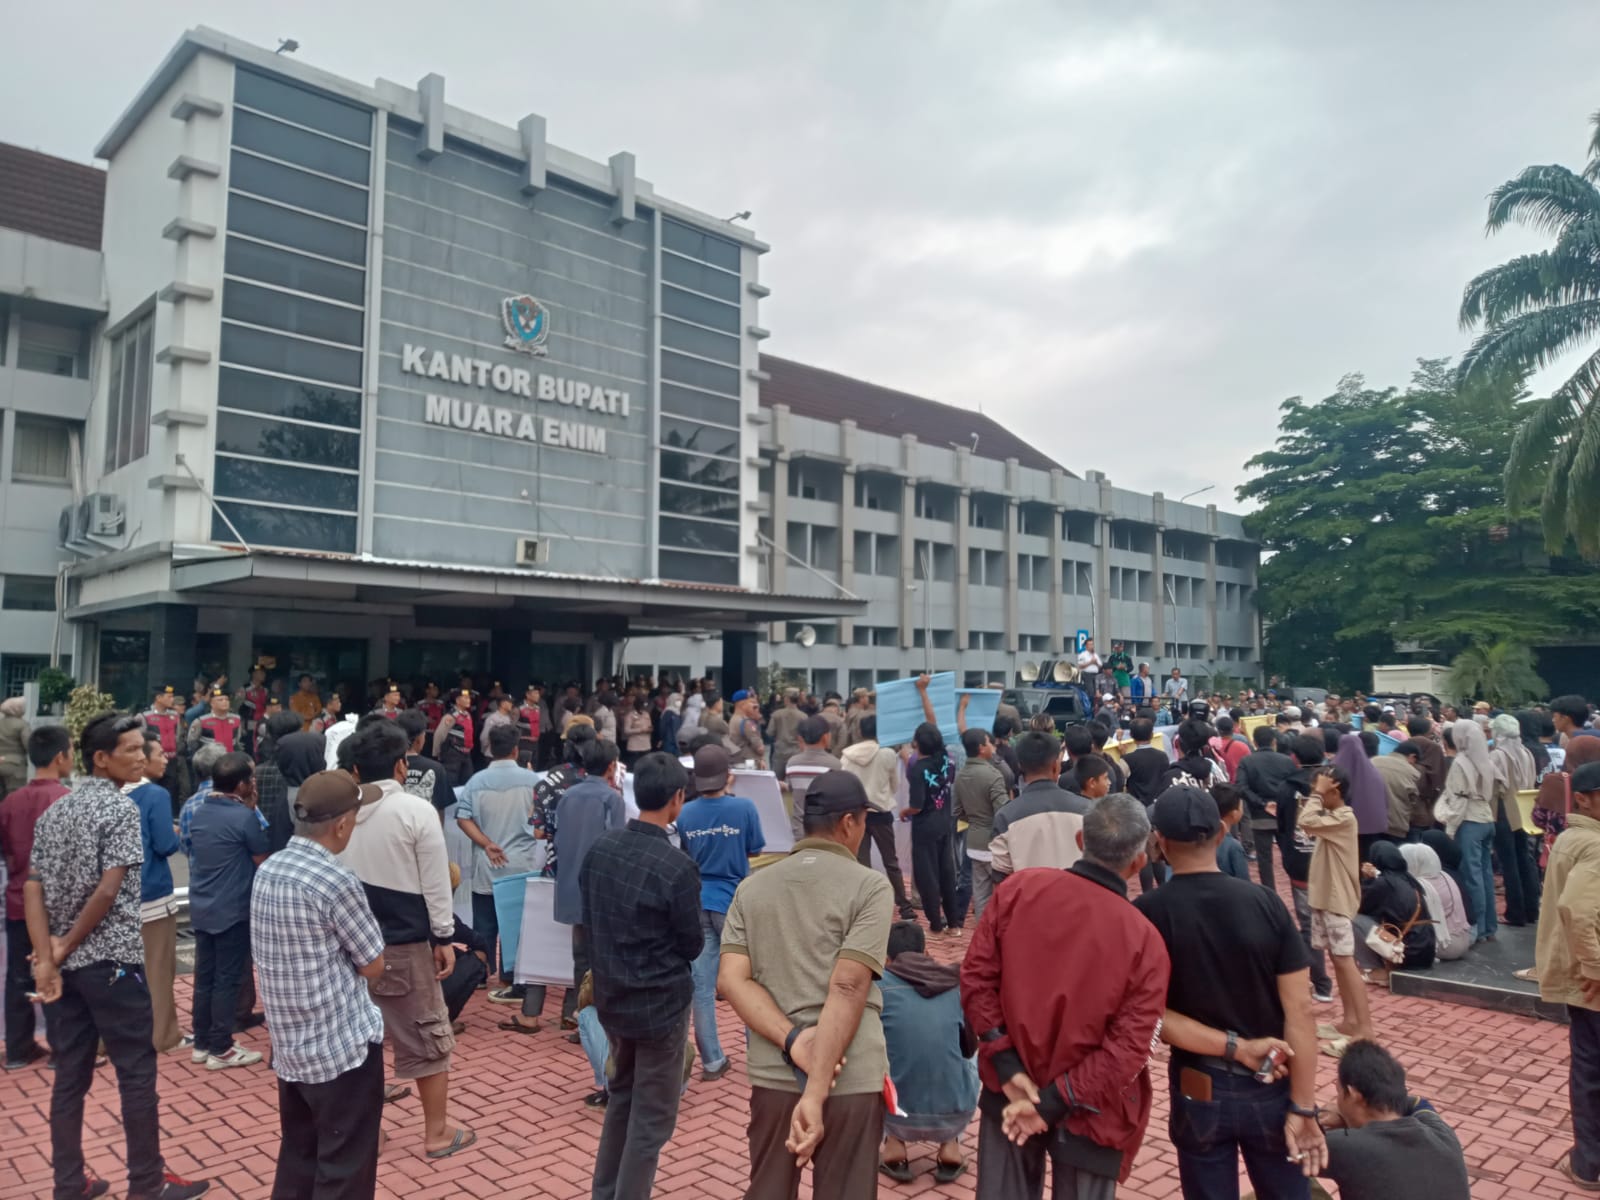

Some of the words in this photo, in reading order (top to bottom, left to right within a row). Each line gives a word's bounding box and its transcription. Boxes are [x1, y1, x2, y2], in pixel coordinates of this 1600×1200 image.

[402, 343, 532, 397] KANTOR
[537, 373, 630, 417] BUPATI
[425, 393, 537, 441] MUARA
[542, 416, 607, 453] ENIM
[1079, 633, 1087, 650] P
